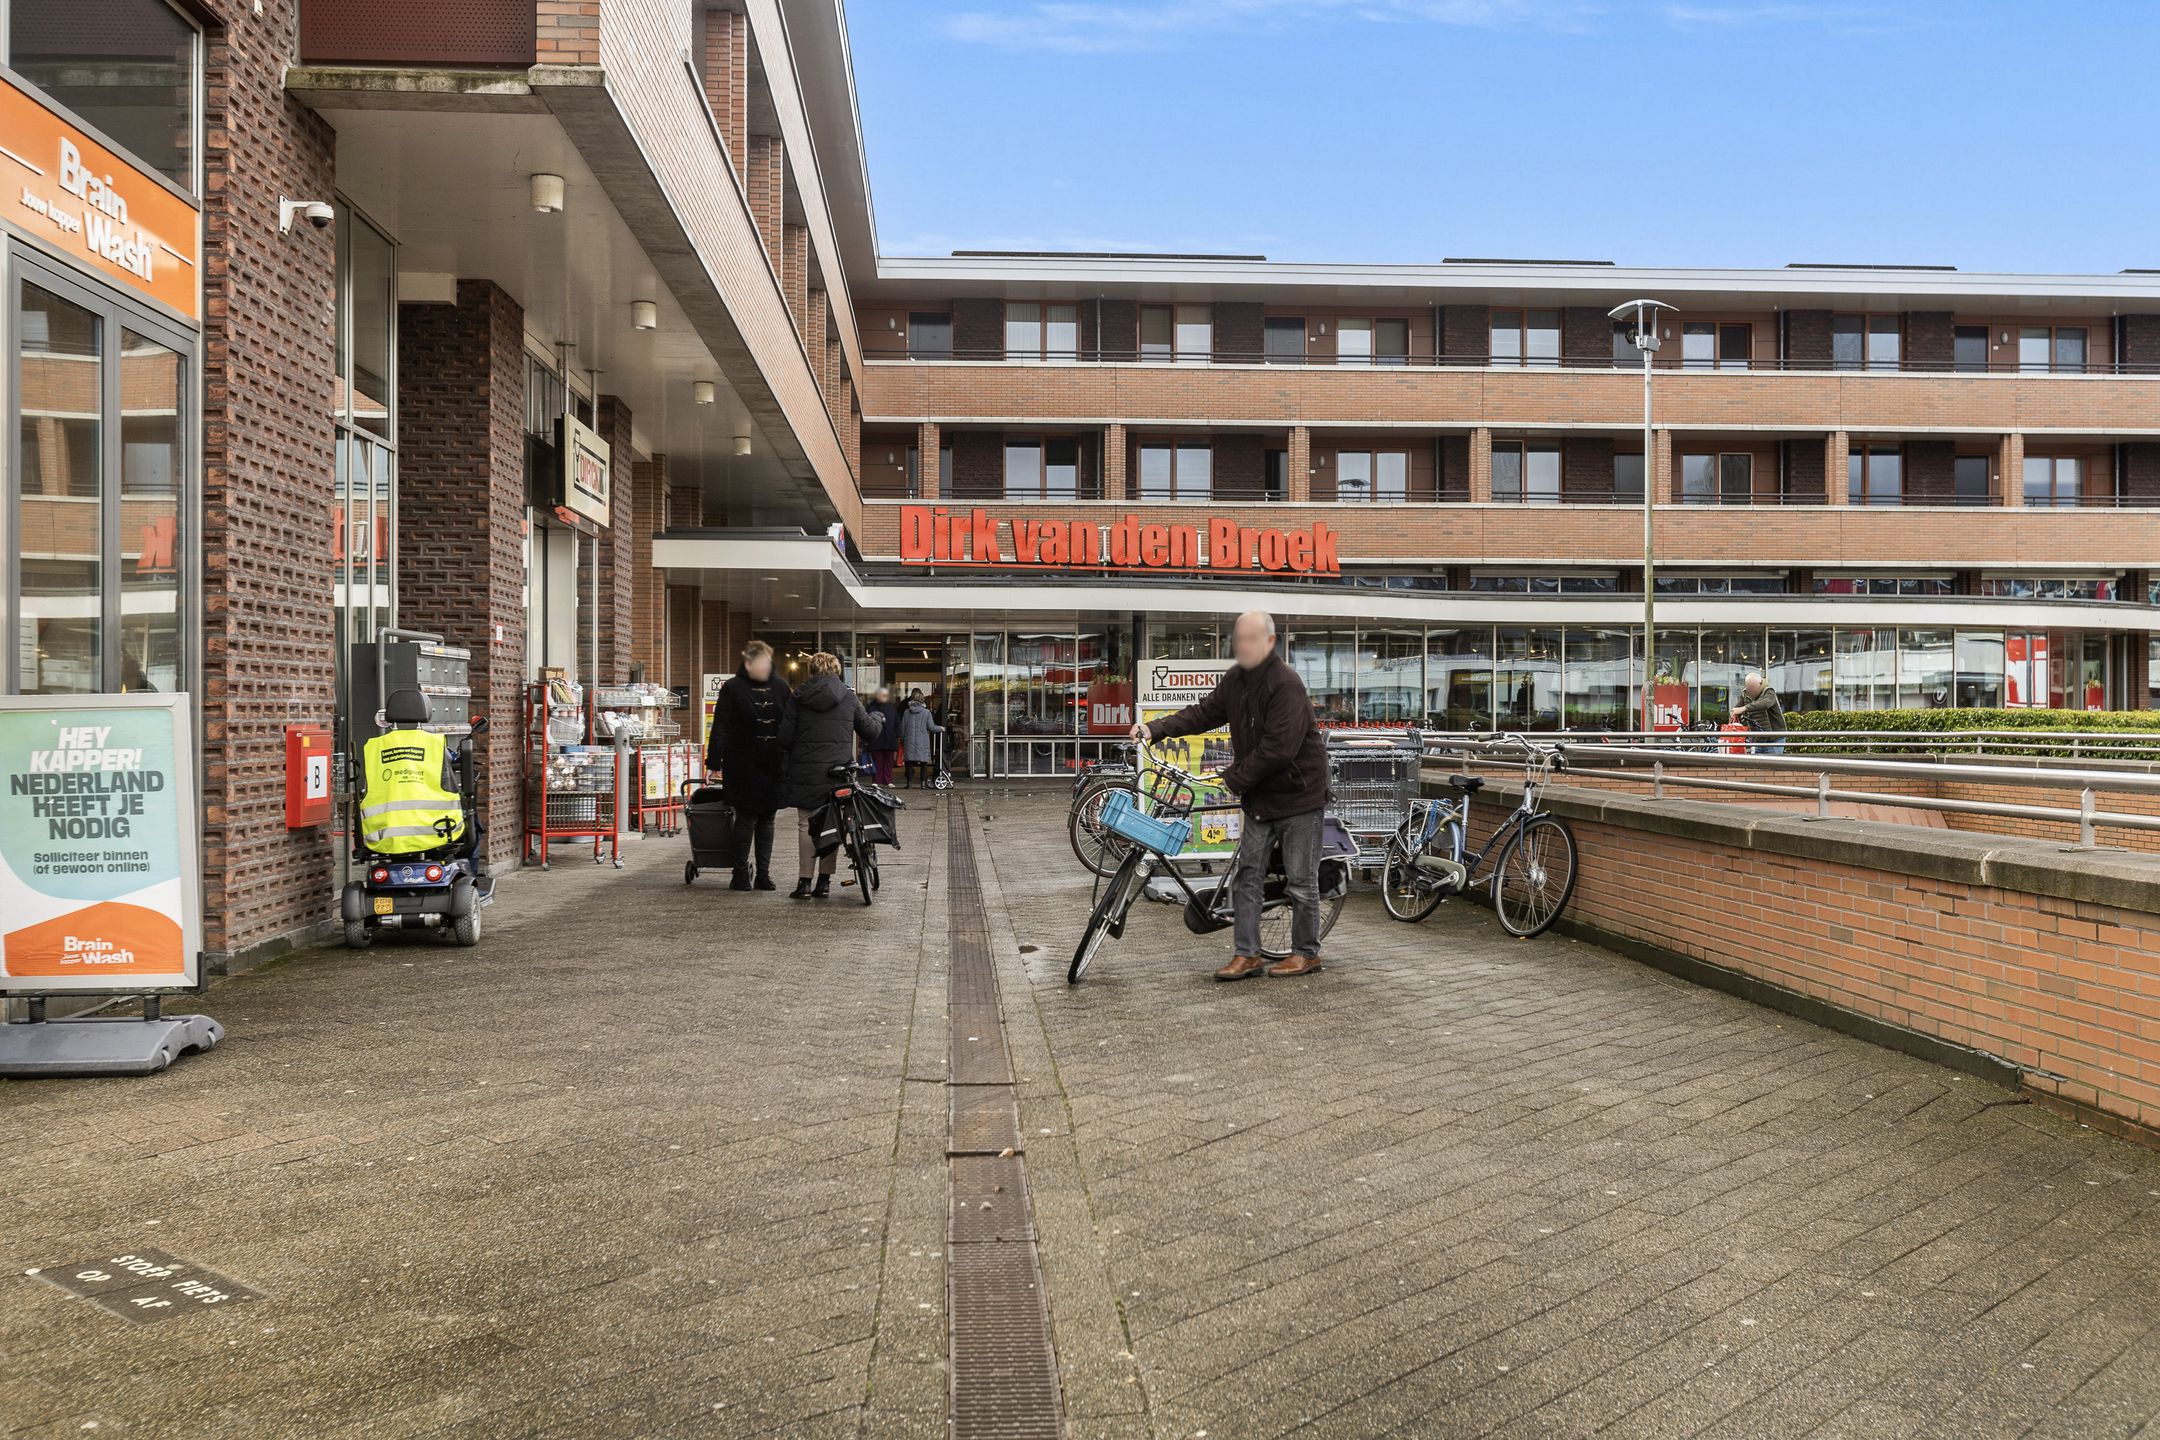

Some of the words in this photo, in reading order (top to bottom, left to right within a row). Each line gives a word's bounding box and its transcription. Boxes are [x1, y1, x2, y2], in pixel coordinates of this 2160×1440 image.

[59, 136, 127, 225] Brain
[83, 211, 152, 283] Wash
[900, 505, 1001, 561] Dirk
[1010, 518, 1099, 564] van
[1109, 514, 1198, 567] den
[1208, 518, 1341, 572] Broek
[1142, 693, 1160, 702] ALLE
[1162, 692, 1196, 702] DRANKEN
[1093, 703, 1131, 724] Dirk
[58, 726, 112, 749] HEY
[30, 748, 143, 773] KAPPER!
[10, 770, 164, 796] NEDERLAND
[314, 765, 321, 789] B
[32, 794, 111, 818] HEEFT
[118, 793, 144, 816] JE
[49, 816, 131, 840] NODIG
[33, 863, 51, 875] (of
[53, 862, 105, 875] gewoon
[107, 861, 150, 874] online)
[34, 851, 100, 863] Solliciteer
[103, 850, 149, 862] binnen
[64, 935, 113, 952] Brain
[82, 948, 135, 965] Wash
[76, 1270, 111, 1283] OP
[110, 1255, 173, 1280] STOEP
[130, 1296, 172, 1309] AF
[171, 1279, 229, 1304] FIETS
